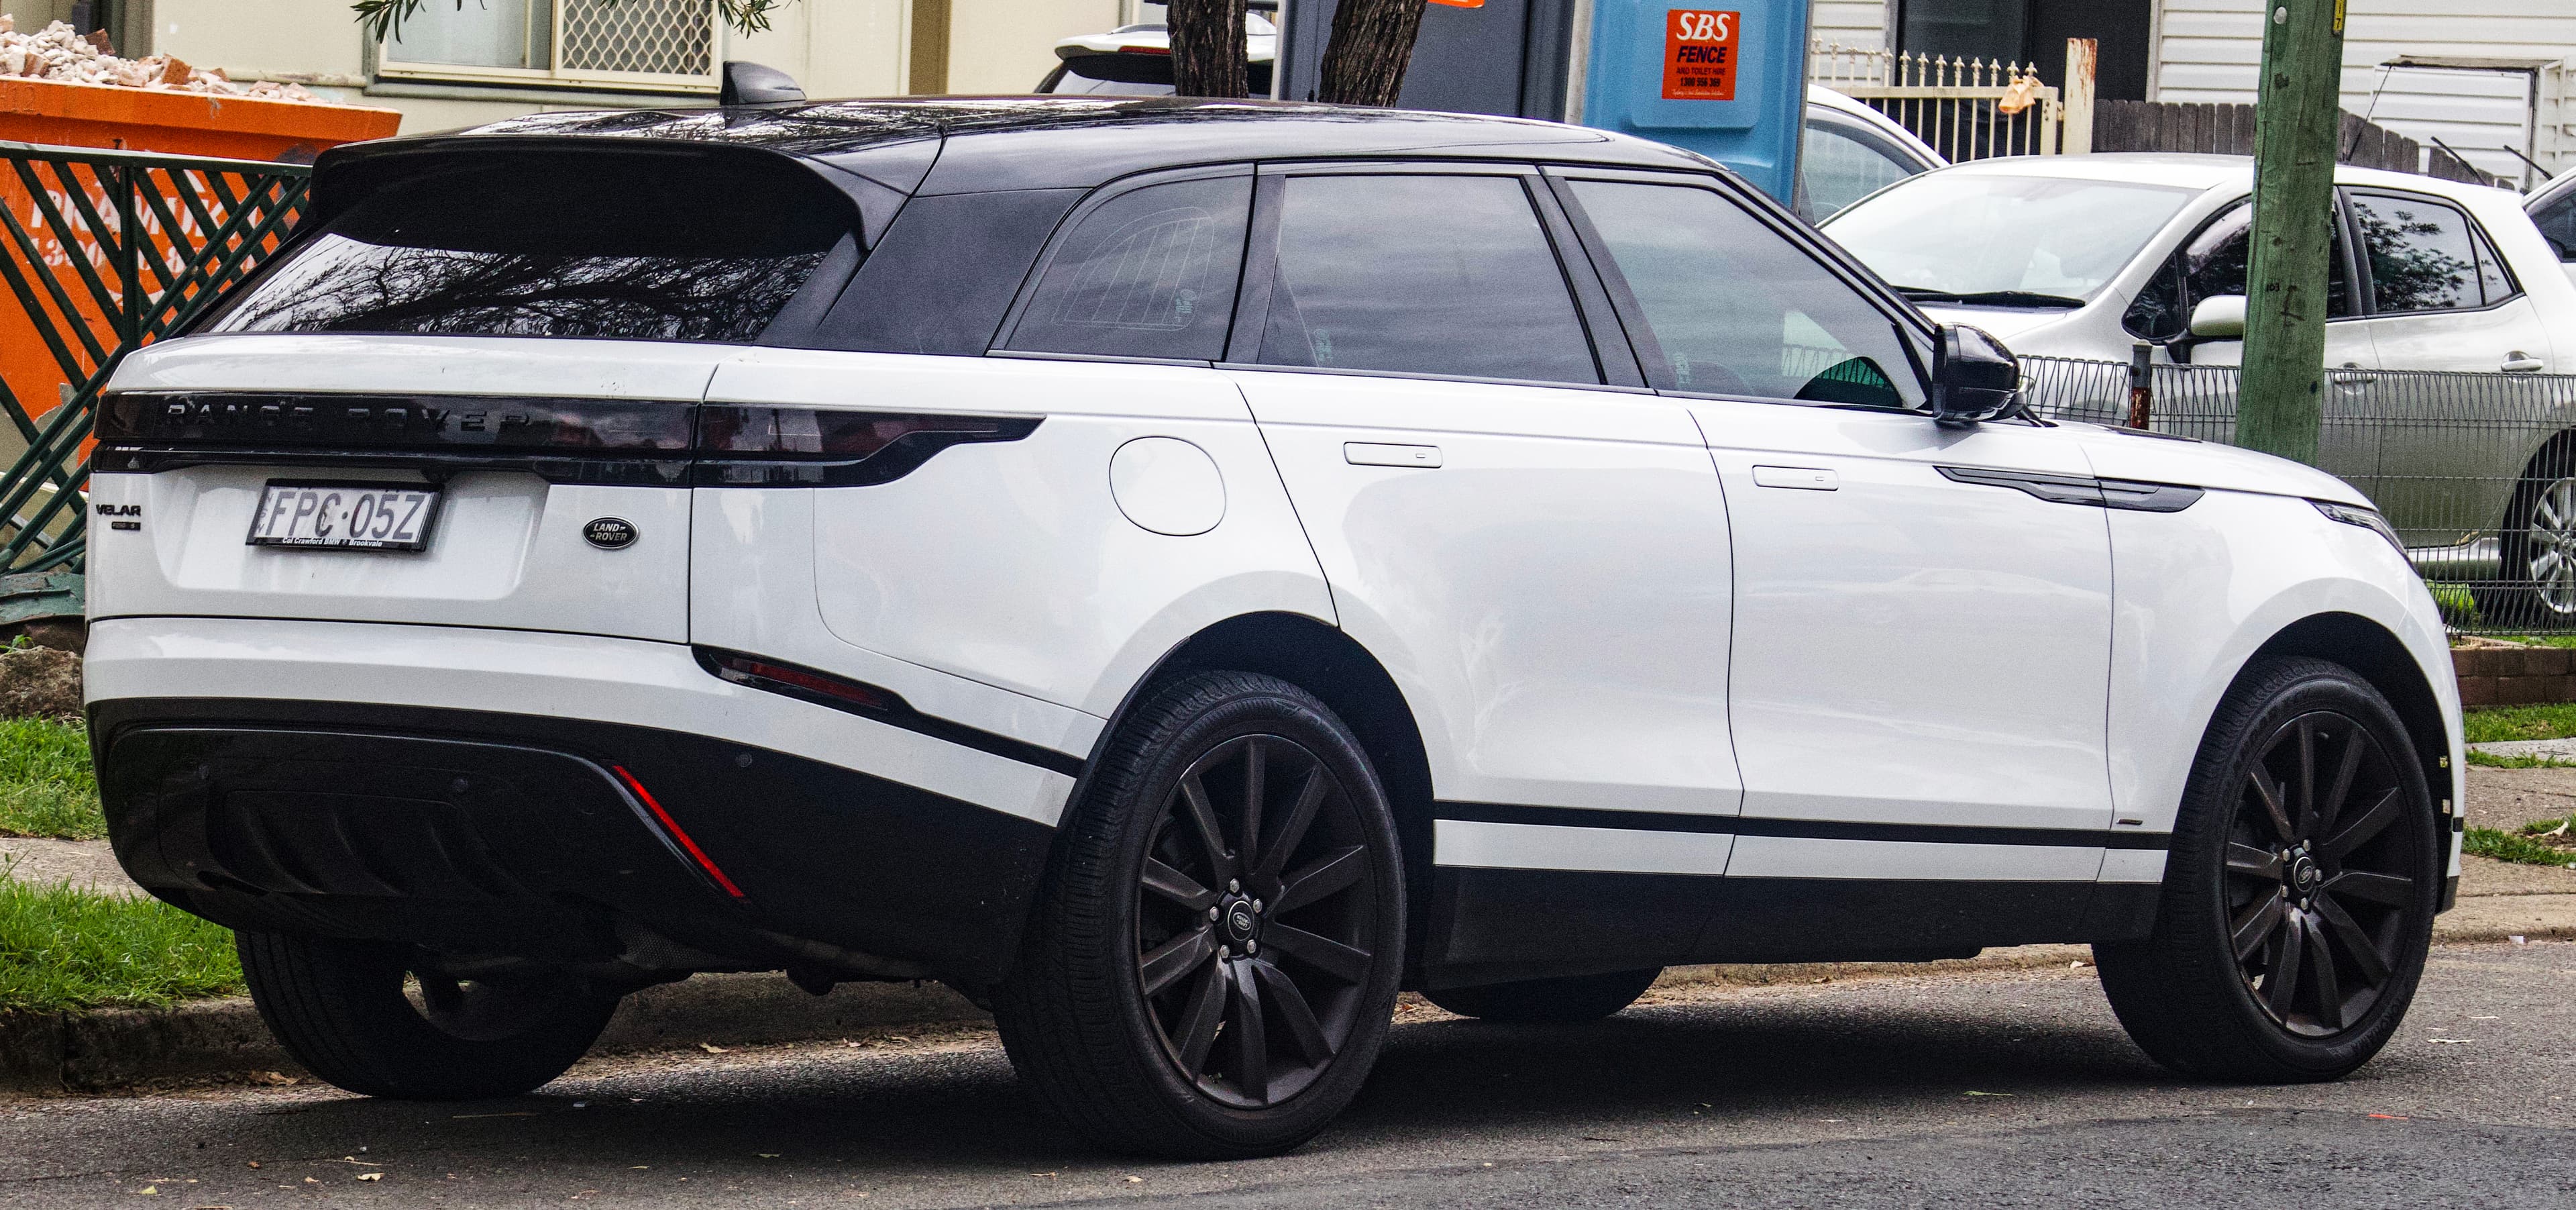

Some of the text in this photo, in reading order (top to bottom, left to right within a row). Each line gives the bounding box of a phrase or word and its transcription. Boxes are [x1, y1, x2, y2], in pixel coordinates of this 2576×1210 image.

[1676, 12, 1730, 41] SBS
[1676, 46, 1727, 64] FENCE
[96, 504, 141, 516] VELAR
[593, 523, 620, 532] LAND
[294, 537, 323, 545] Crawford
[349, 539, 382, 547] Brookvale
[595, 532, 627, 541] ROVER
